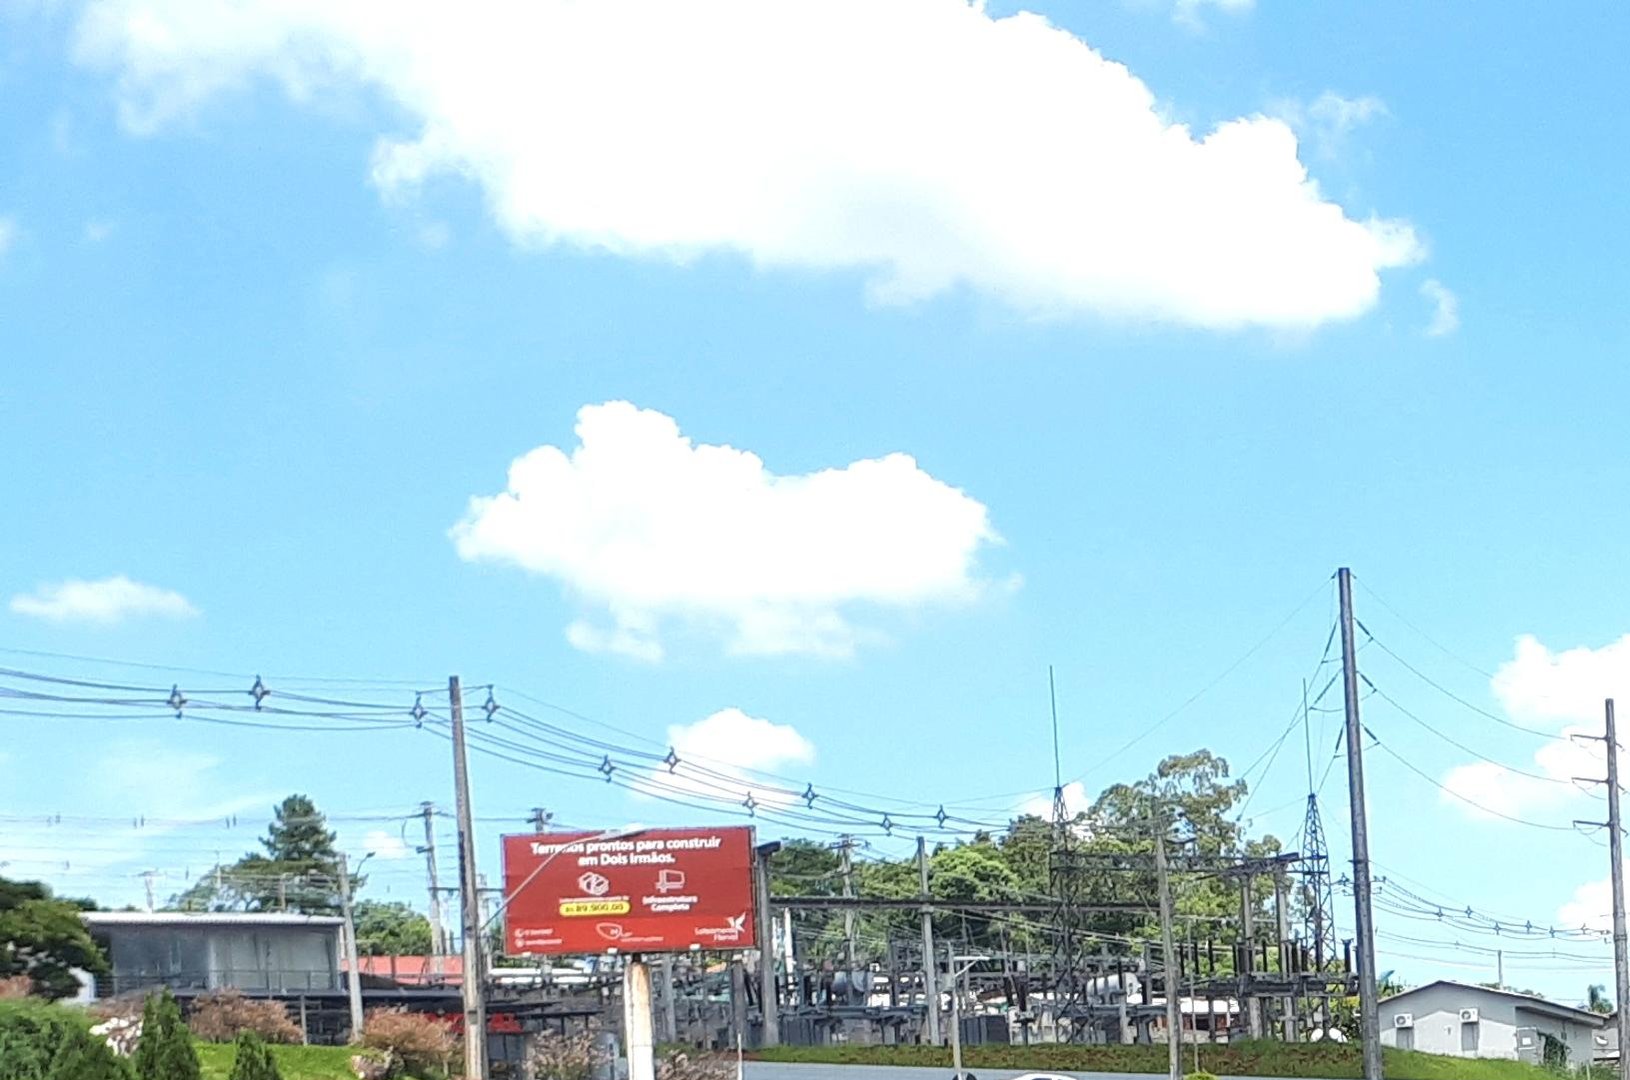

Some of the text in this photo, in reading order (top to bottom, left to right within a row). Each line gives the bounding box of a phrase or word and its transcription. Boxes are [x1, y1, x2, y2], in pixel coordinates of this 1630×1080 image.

[586, 841, 634, 854] prontos
[636, 840, 664, 852] para
[666, 836, 721, 849] construir
[578, 856, 599, 866] em
[600, 853, 628, 865] Dois
